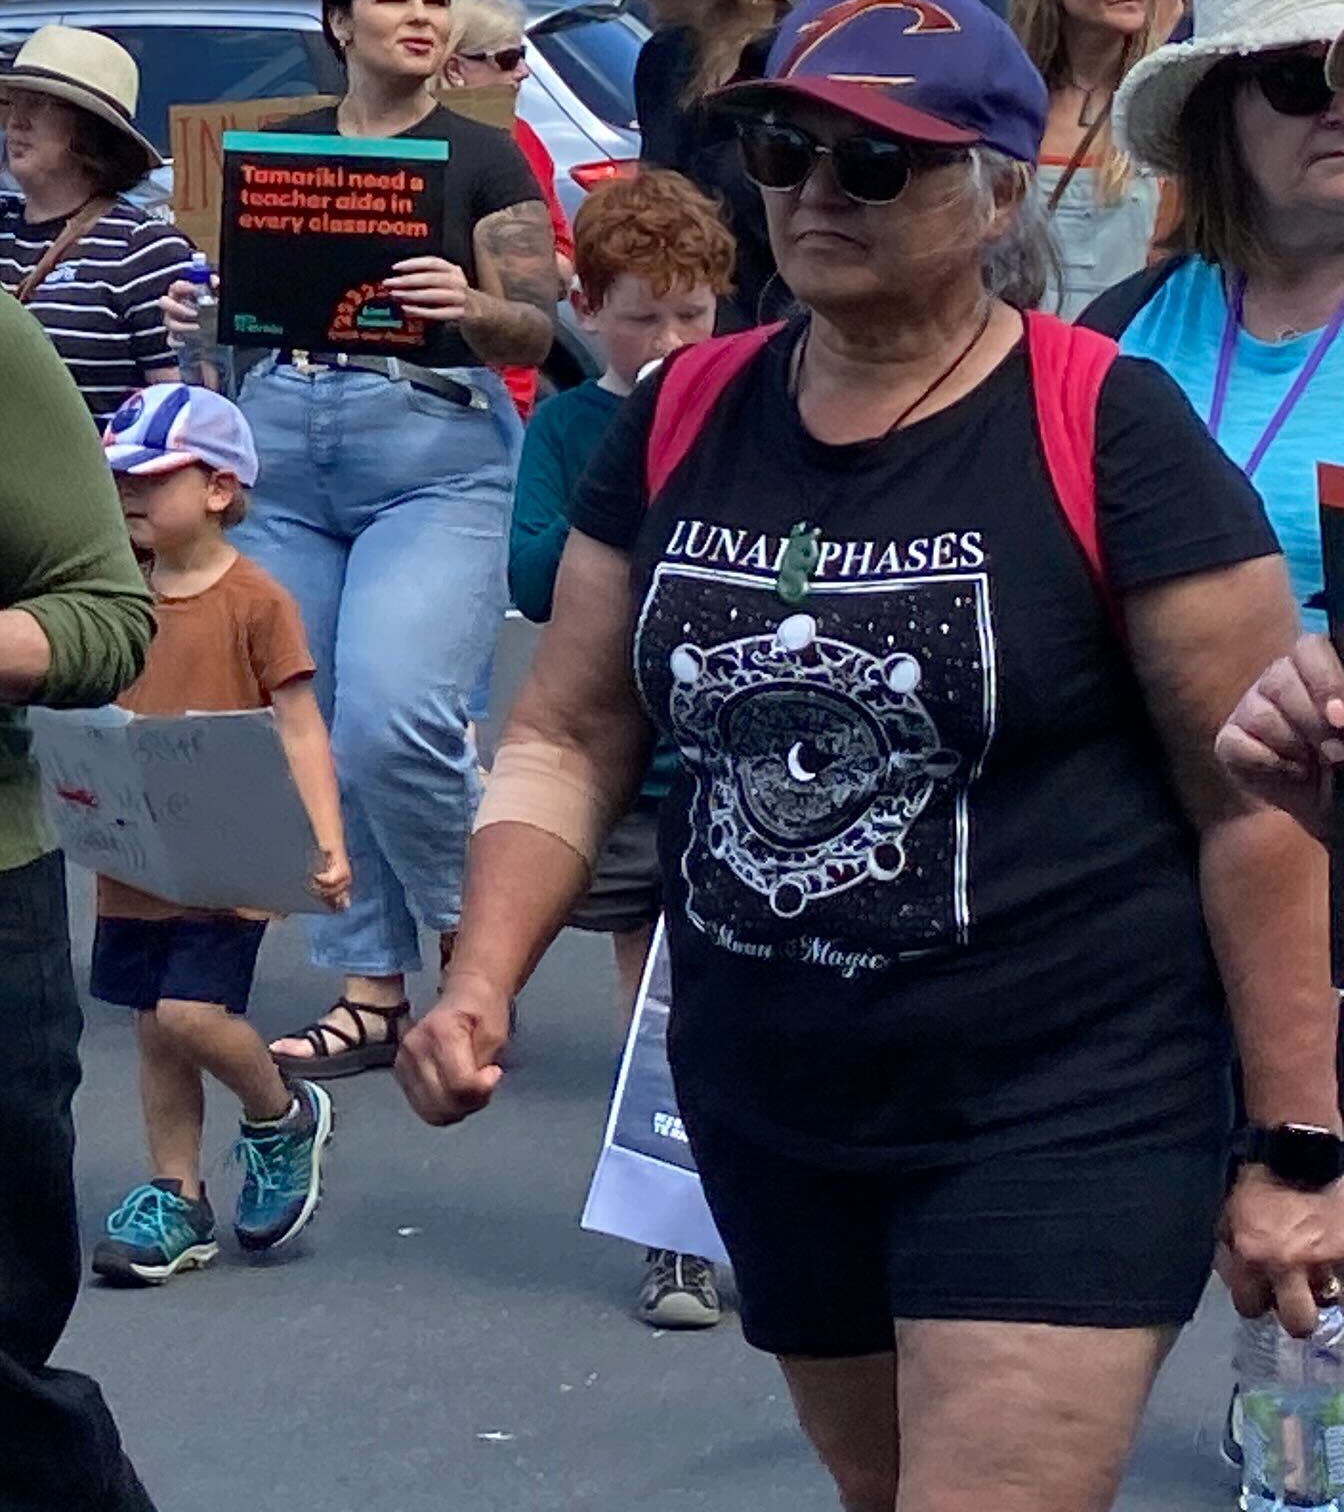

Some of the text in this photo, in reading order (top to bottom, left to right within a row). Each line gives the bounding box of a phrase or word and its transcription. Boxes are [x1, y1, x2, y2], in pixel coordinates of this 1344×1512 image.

[240, 164, 425, 192] Tamariki need a
[240, 189, 413, 215] teacher aide in
[238, 212, 429, 237] every classroom
[815, 532, 985, 577] PHASES
[801, 935, 889, 980] Magic
